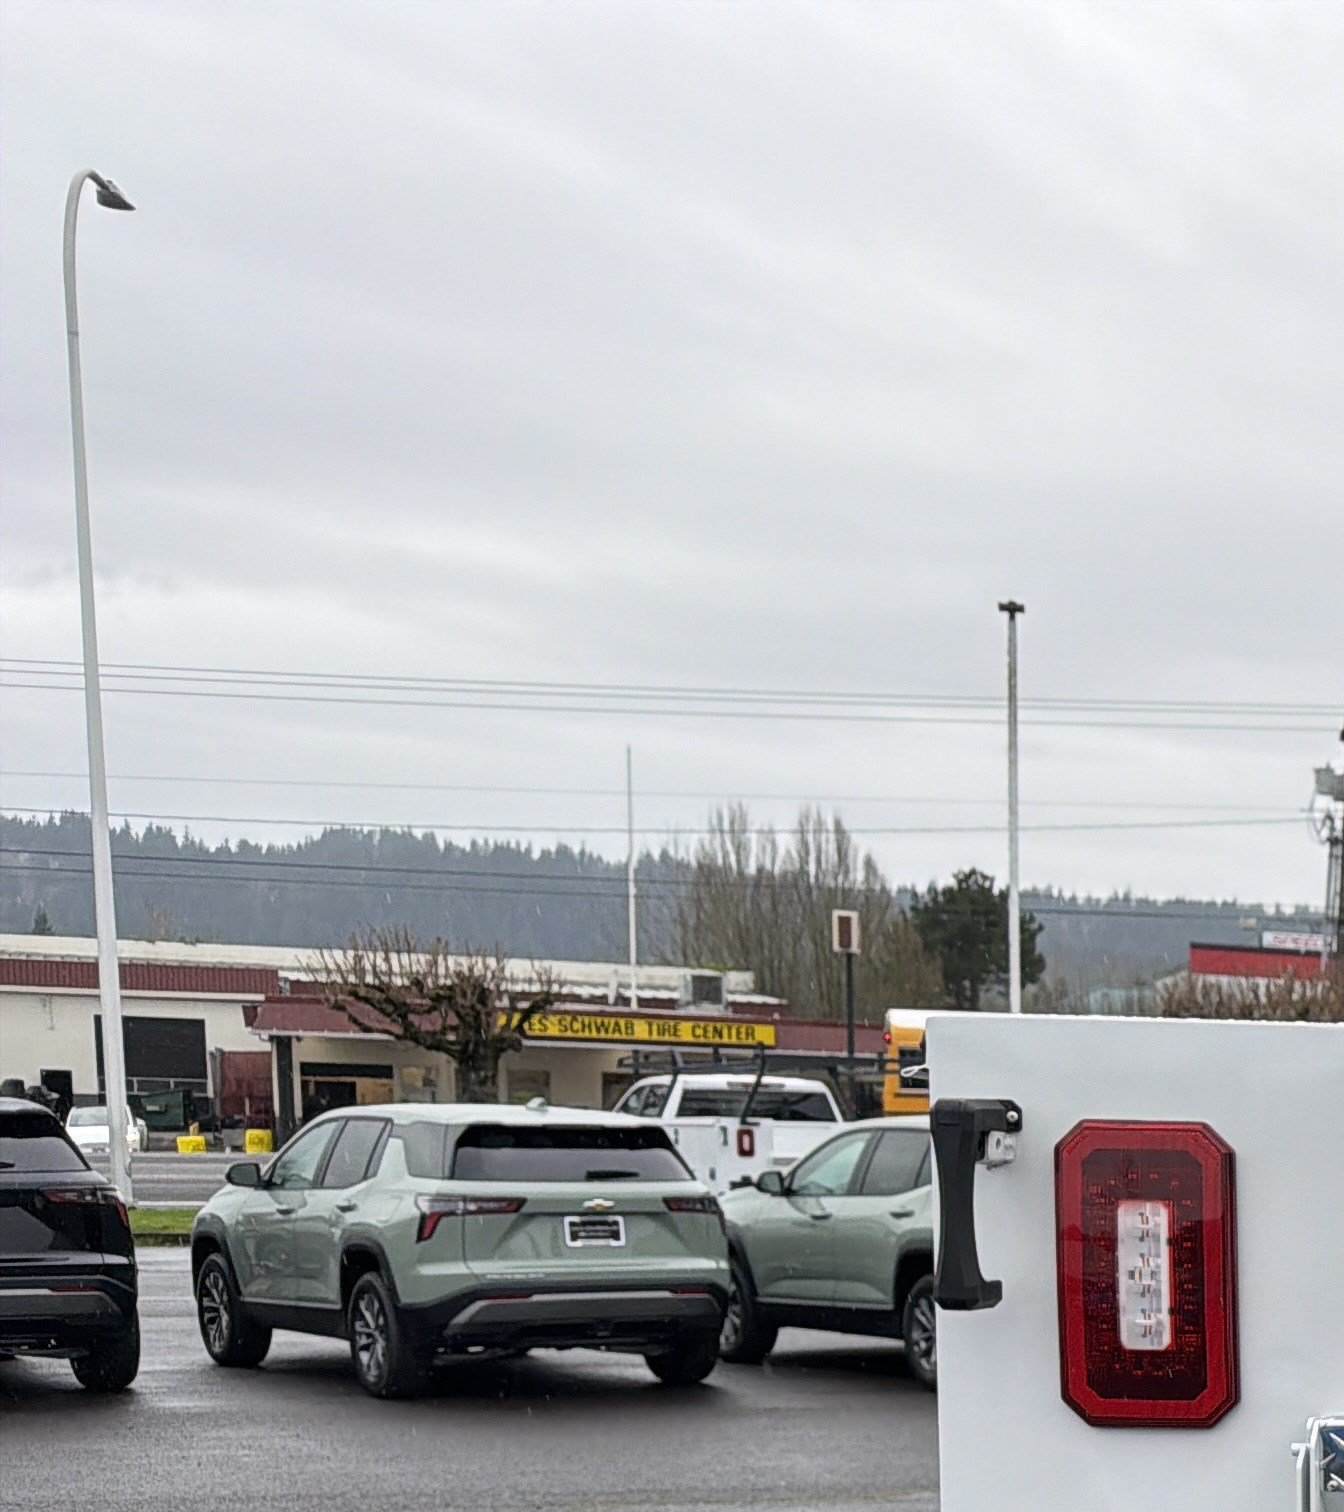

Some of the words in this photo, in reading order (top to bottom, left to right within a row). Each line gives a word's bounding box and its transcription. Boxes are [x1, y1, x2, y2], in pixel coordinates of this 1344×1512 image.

[525, 1014, 548, 1033] ES
[557, 1015, 635, 1036] SCHWAB
[646, 1020, 680, 1038] TIRE
[691, 1023, 756, 1041] CENTER
